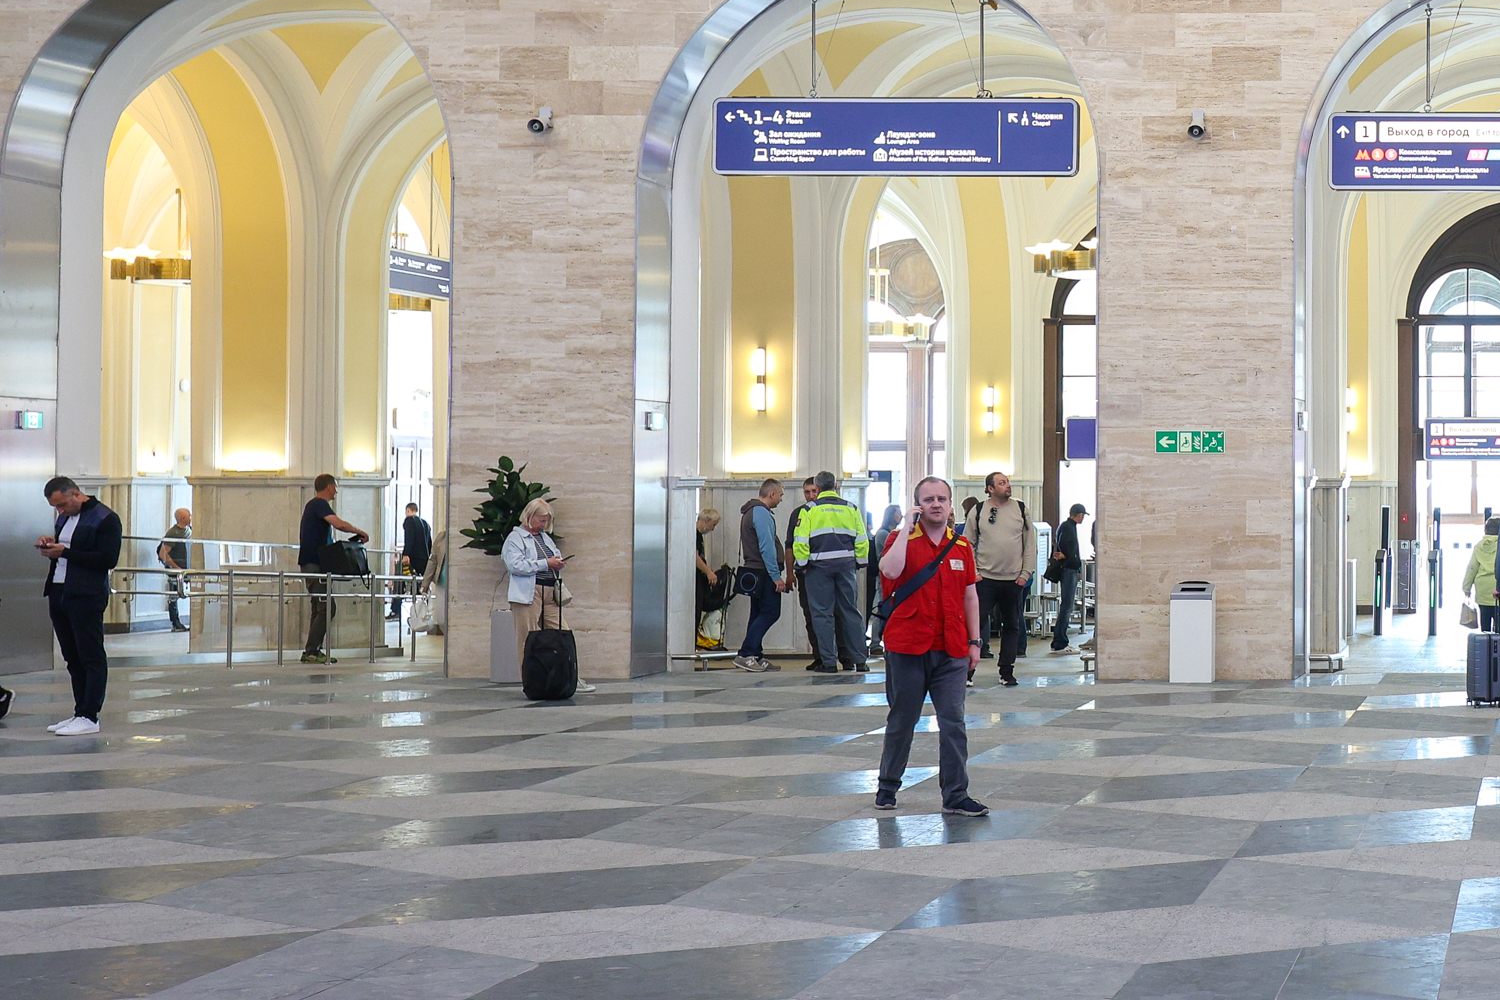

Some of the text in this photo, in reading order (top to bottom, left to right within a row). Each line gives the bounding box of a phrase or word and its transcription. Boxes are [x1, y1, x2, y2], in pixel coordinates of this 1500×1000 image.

[786, 110, 811, 118] Этажи
[1032, 112, 1063, 120] Часовня
[769, 130, 783, 138] Зал
[887, 131, 935, 139] Лаундж-зона
[1362, 126, 1369, 138] 1
[1387, 126, 1424, 138] Выход
[1436, 129, 1470, 138] город
[1476, 129, 1491, 137] Exit
[770, 148, 822, 156] Пространство
[838, 148, 865, 157] работы
[889, 148, 913, 157] Музей
[1399, 148, 1452, 156] Комсомольская
[1373, 166, 1417, 174] Ярославский
